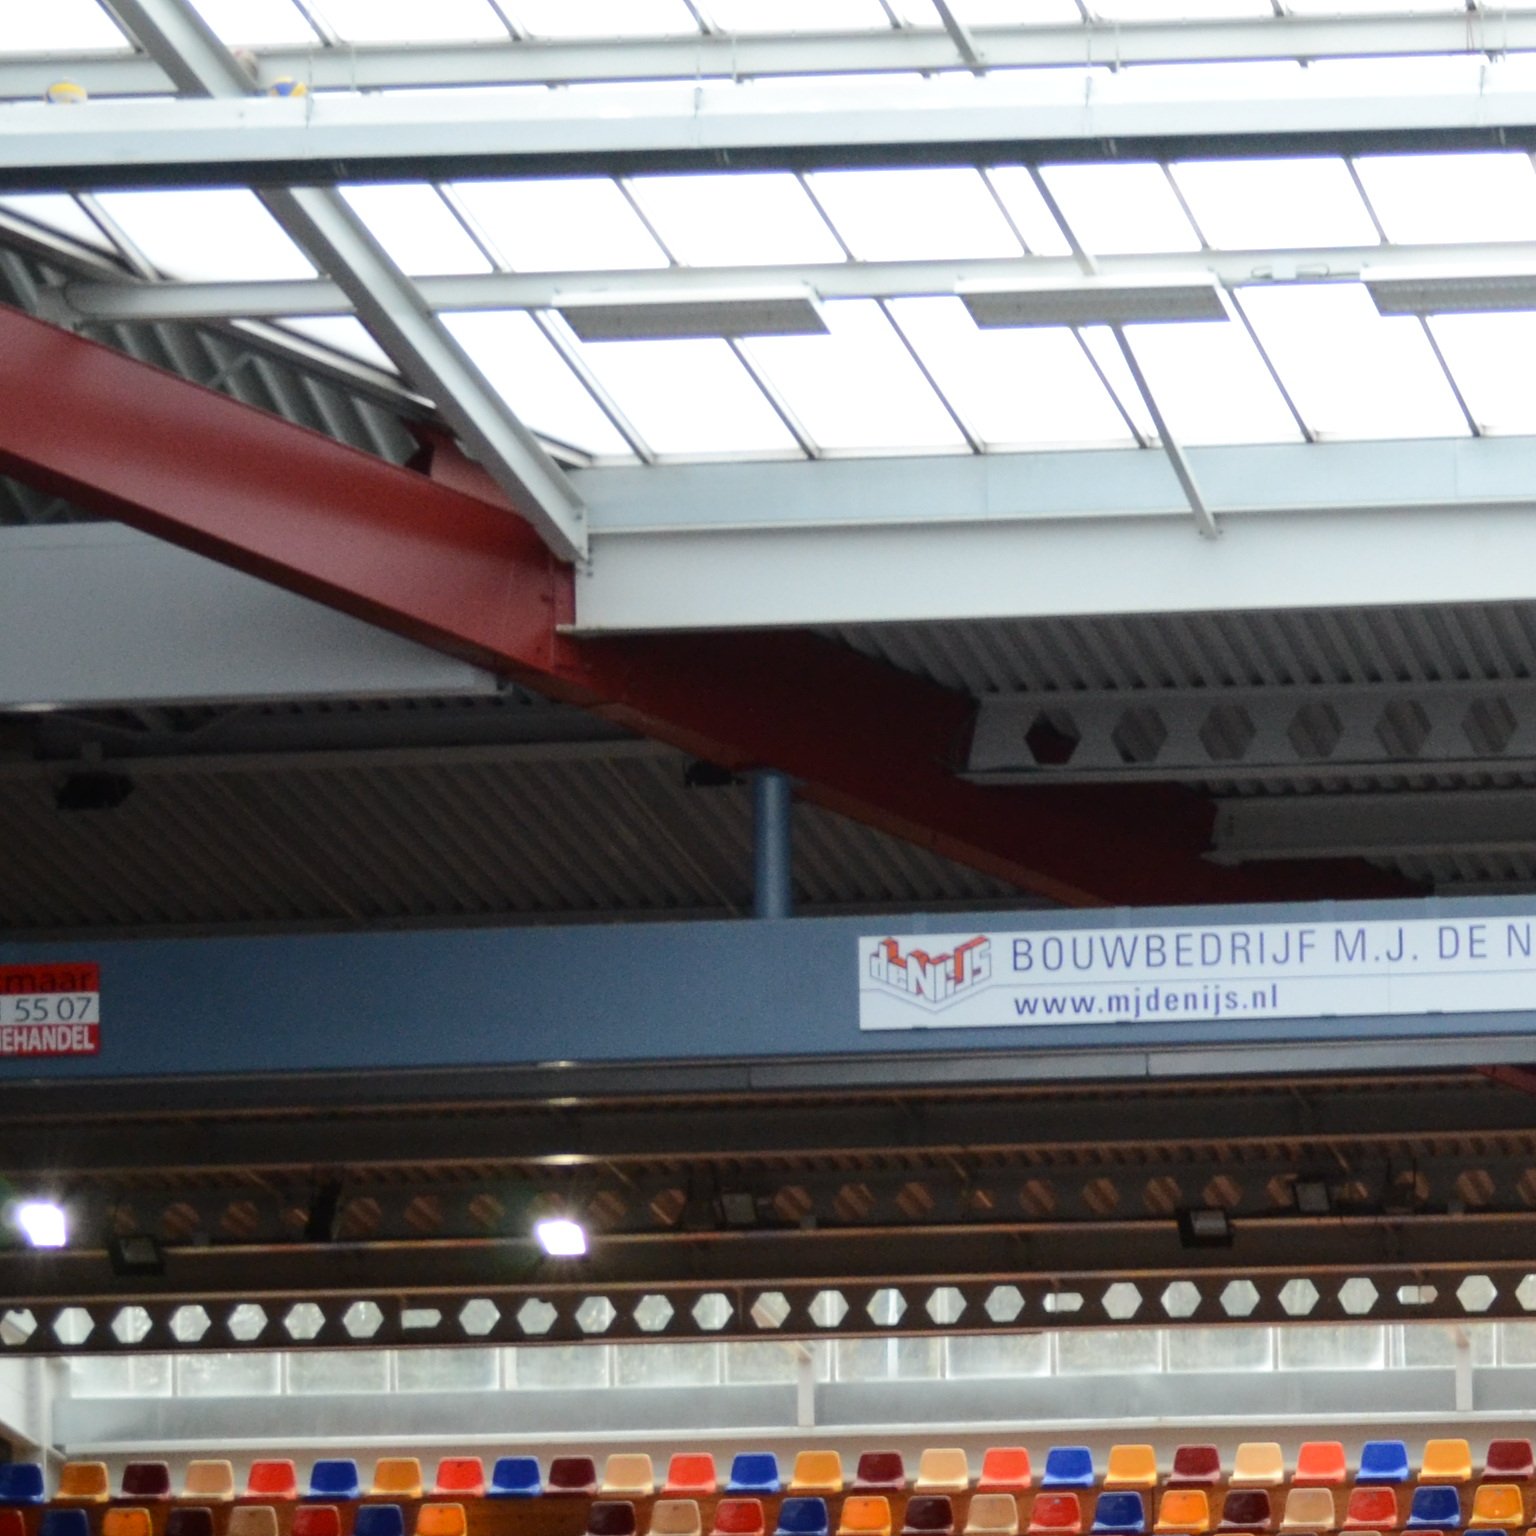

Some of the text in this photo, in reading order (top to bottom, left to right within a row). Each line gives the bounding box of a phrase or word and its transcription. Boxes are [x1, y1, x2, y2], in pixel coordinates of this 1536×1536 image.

[1012, 930, 1317, 972] BOUWBEDRIJF
[1334, 924, 1419, 965] M.J.
[1438, 924, 1489, 961] DE
[15, 996, 92, 1021] 55 07
[1014, 983, 1279, 1018] www.mjdenijs.nl
[2, 1023, 95, 1052] EHANDEL
